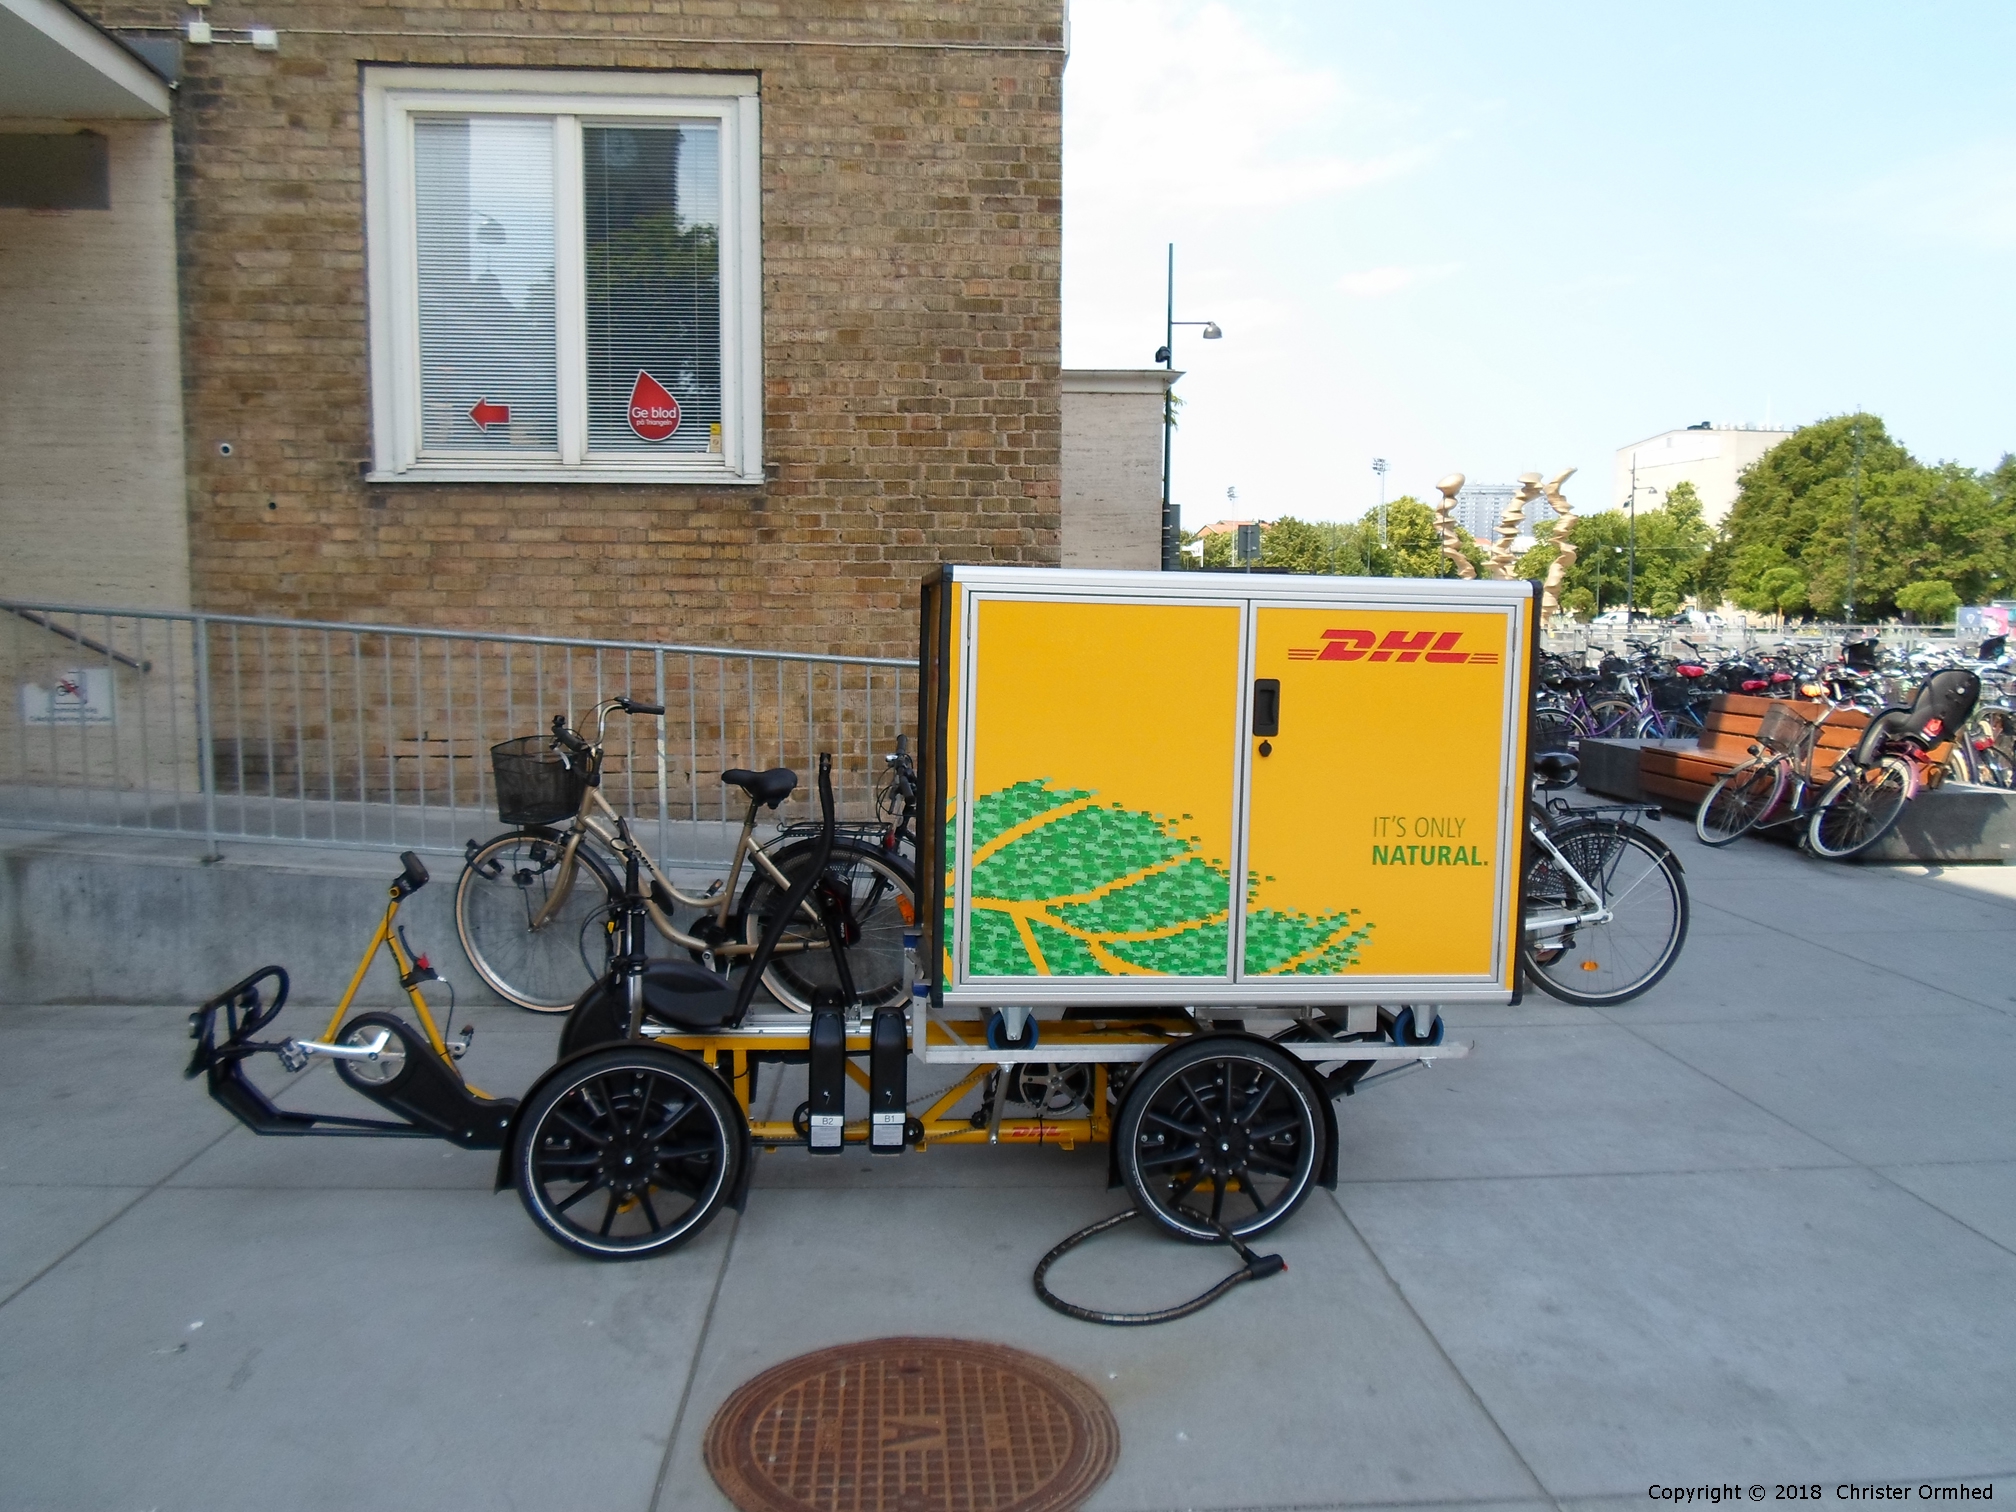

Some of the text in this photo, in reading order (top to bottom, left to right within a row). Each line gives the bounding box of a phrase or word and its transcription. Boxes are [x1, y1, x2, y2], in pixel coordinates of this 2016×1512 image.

[631, 406, 677, 419] Ge blod
[1316, 629, 1472, 664] DHL
[1373, 815, 1467, 838] IT'S ONLY
[1371, 845, 1489, 866] NATURAL.
[822, 1117, 834, 1126] B2
[884, 1114, 895, 1123] B1
[1011, 1126, 1061, 1138] DHL
